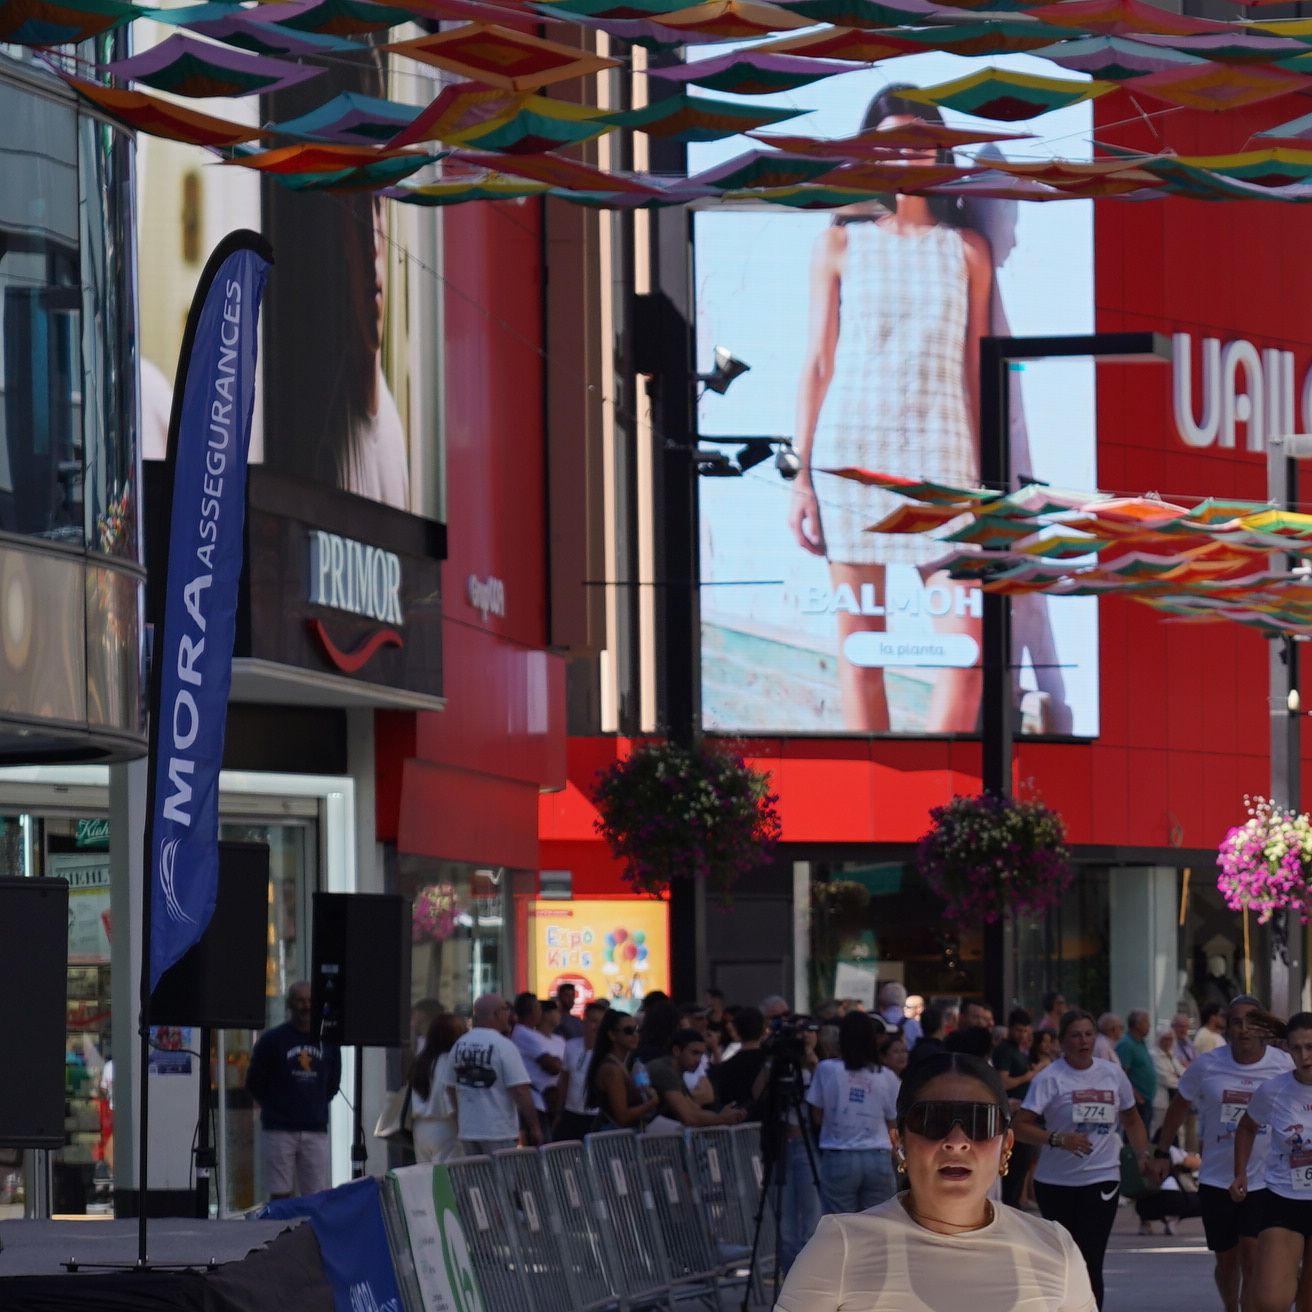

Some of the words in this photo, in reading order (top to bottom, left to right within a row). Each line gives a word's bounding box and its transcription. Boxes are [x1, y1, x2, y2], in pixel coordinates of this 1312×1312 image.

[163, 574, 213, 827] MORA
[197, 279, 242, 569] ASSEGURANCES
[314, 530, 403, 625] PRIMOR
